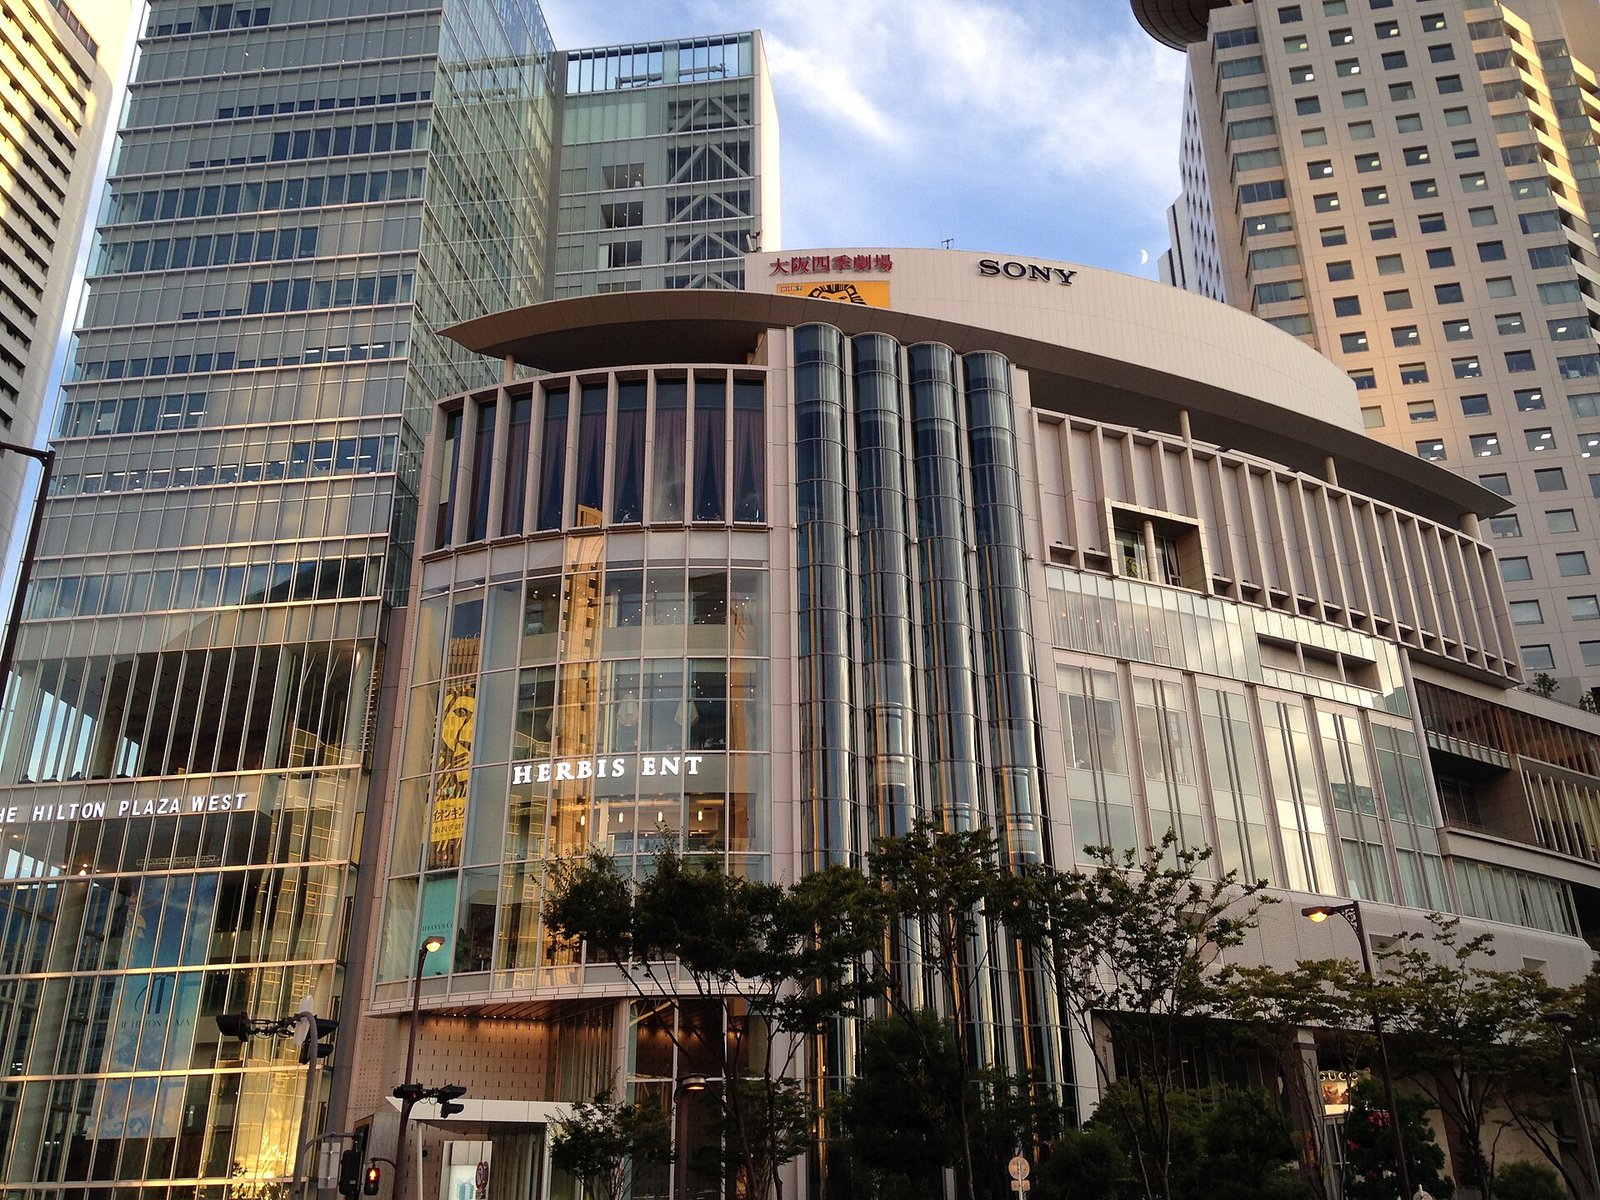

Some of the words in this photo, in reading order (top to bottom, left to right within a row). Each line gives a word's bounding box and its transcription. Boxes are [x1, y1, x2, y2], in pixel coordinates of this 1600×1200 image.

[769, 254, 893, 275] 大阪四季劇場
[979, 259, 1077, 285] SONY
[512, 758, 625, 784] HERBIS
[641, 756, 702, 776] ENT
[32, 801, 105, 821] HILTON
[118, 798, 180, 817] PLAZA
[191, 793, 247, 812] WEST
